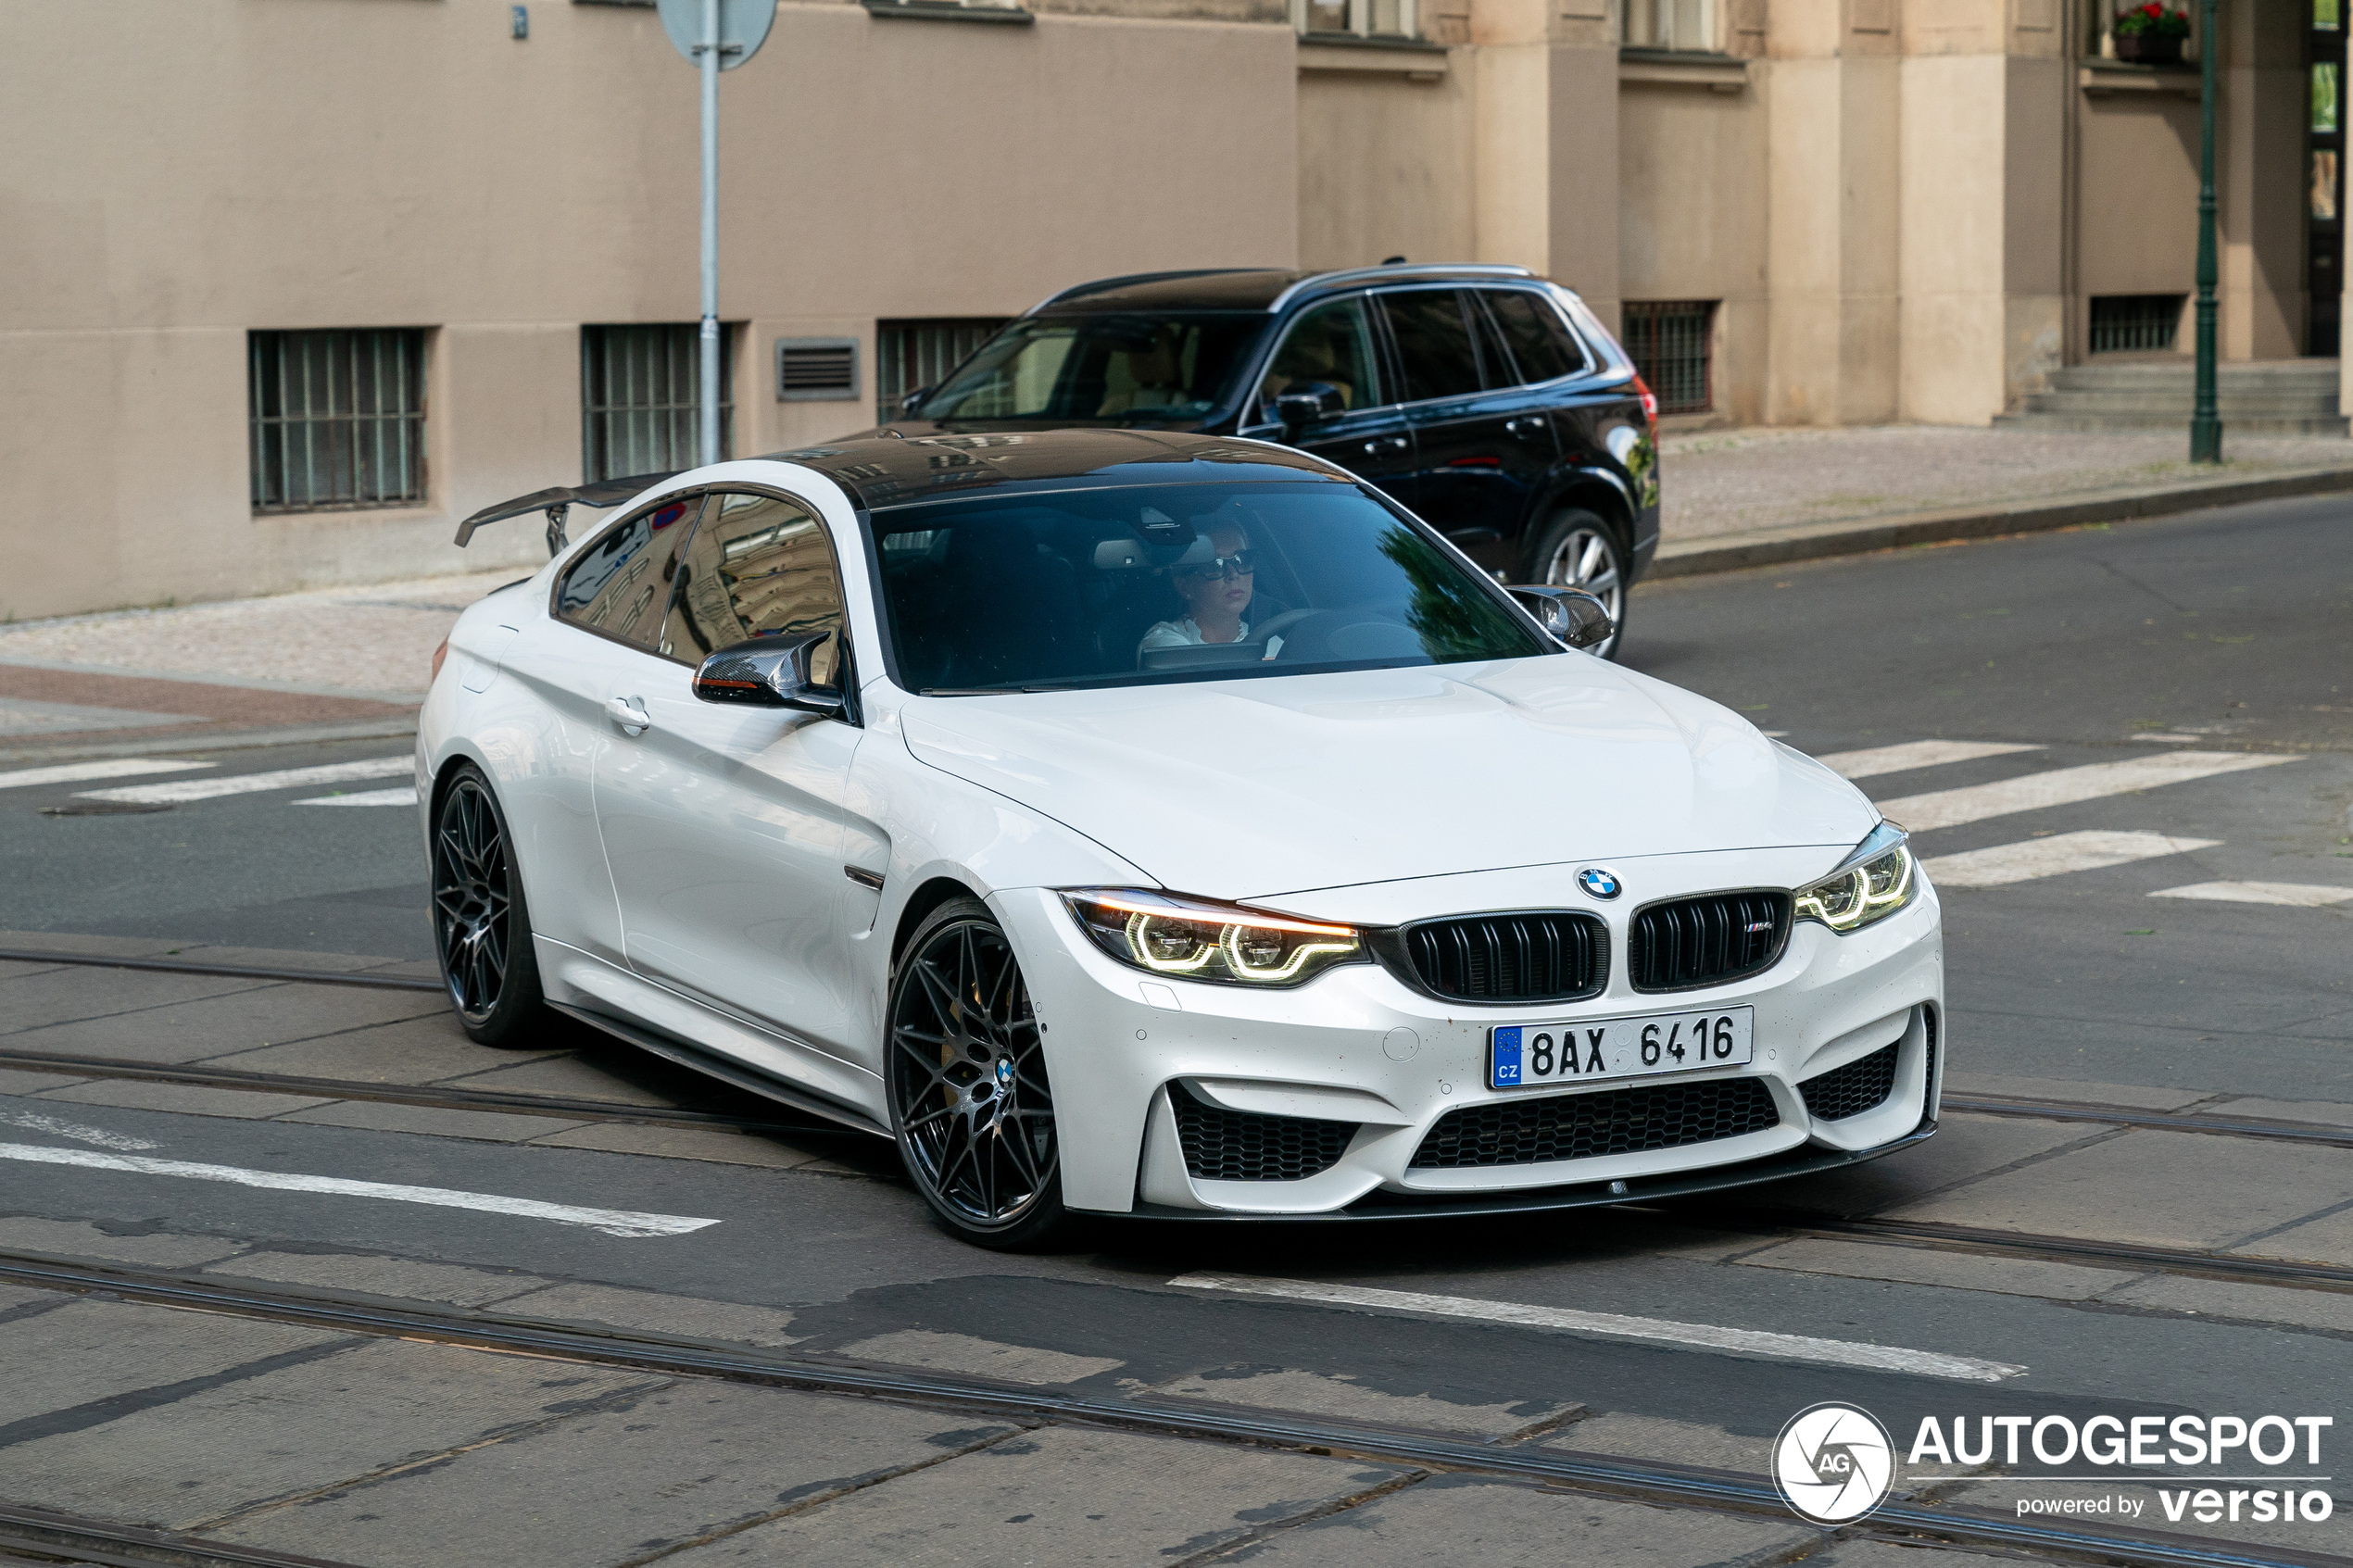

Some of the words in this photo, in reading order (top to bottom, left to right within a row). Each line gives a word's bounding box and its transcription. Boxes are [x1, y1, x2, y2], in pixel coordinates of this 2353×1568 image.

[1531, 1027, 1606, 1076] 8AX
[1640, 1016, 1734, 1065] 6416
[1499, 1065, 1518, 1079] CZ
